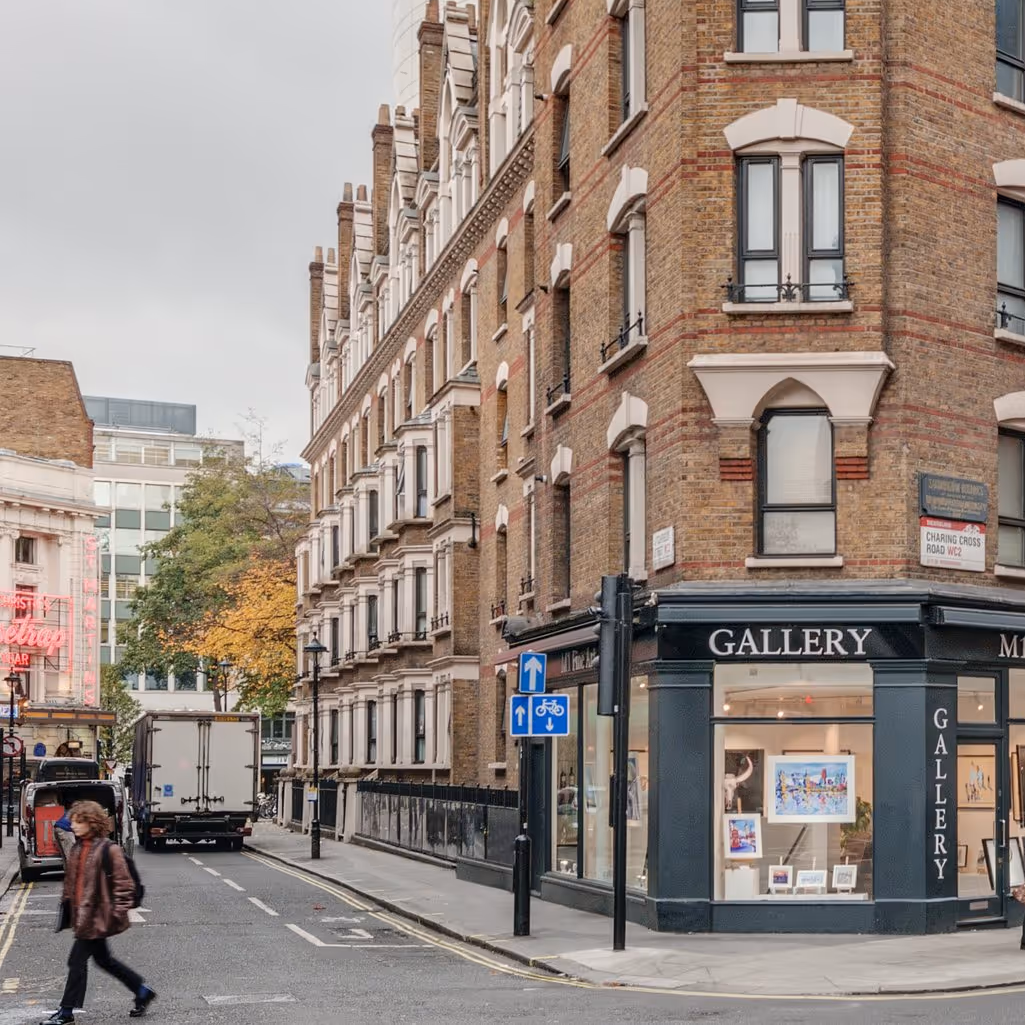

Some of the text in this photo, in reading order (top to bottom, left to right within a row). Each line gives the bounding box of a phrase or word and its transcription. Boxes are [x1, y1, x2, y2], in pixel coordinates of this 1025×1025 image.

[84, 535, 98, 571] ST
[926, 531, 981, 548] CHARING CROSS
[926, 543, 962, 557] ROAD WC2
[708, 627, 872, 656] GALLERY
[933, 707, 949, 880] GALLERY
